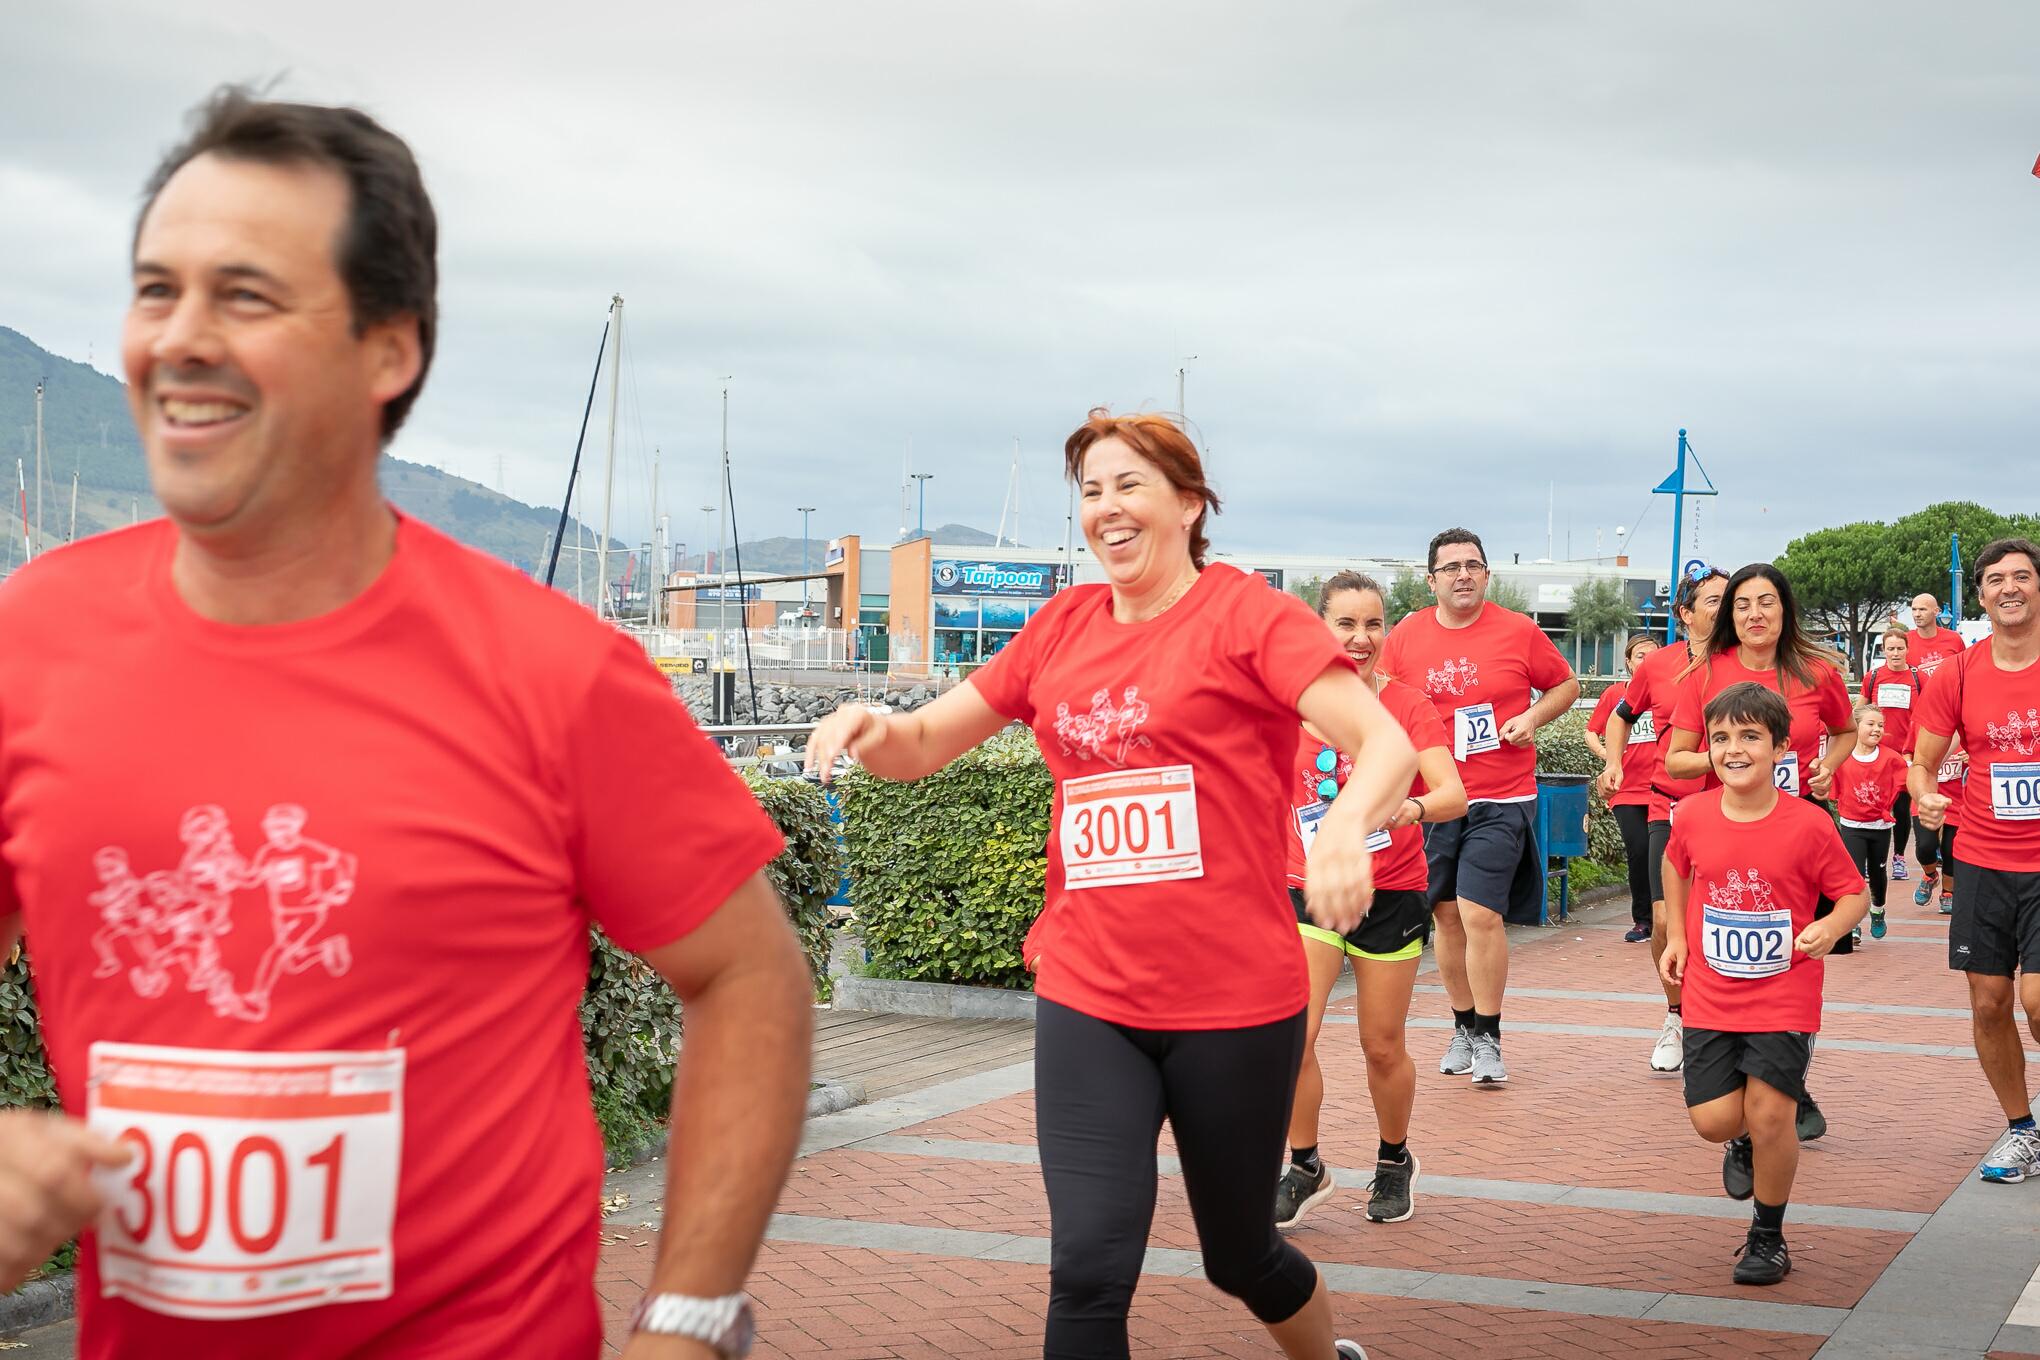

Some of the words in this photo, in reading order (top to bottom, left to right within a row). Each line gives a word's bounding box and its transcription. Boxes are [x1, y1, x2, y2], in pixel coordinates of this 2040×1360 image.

[962, 567, 1043, 588] Tarpoon
[1630, 719, 1656, 735] 049
[1073, 800, 1175, 859] 3001
[1711, 927, 1783, 962] 1002
[113, 1127, 347, 1255] 3001
